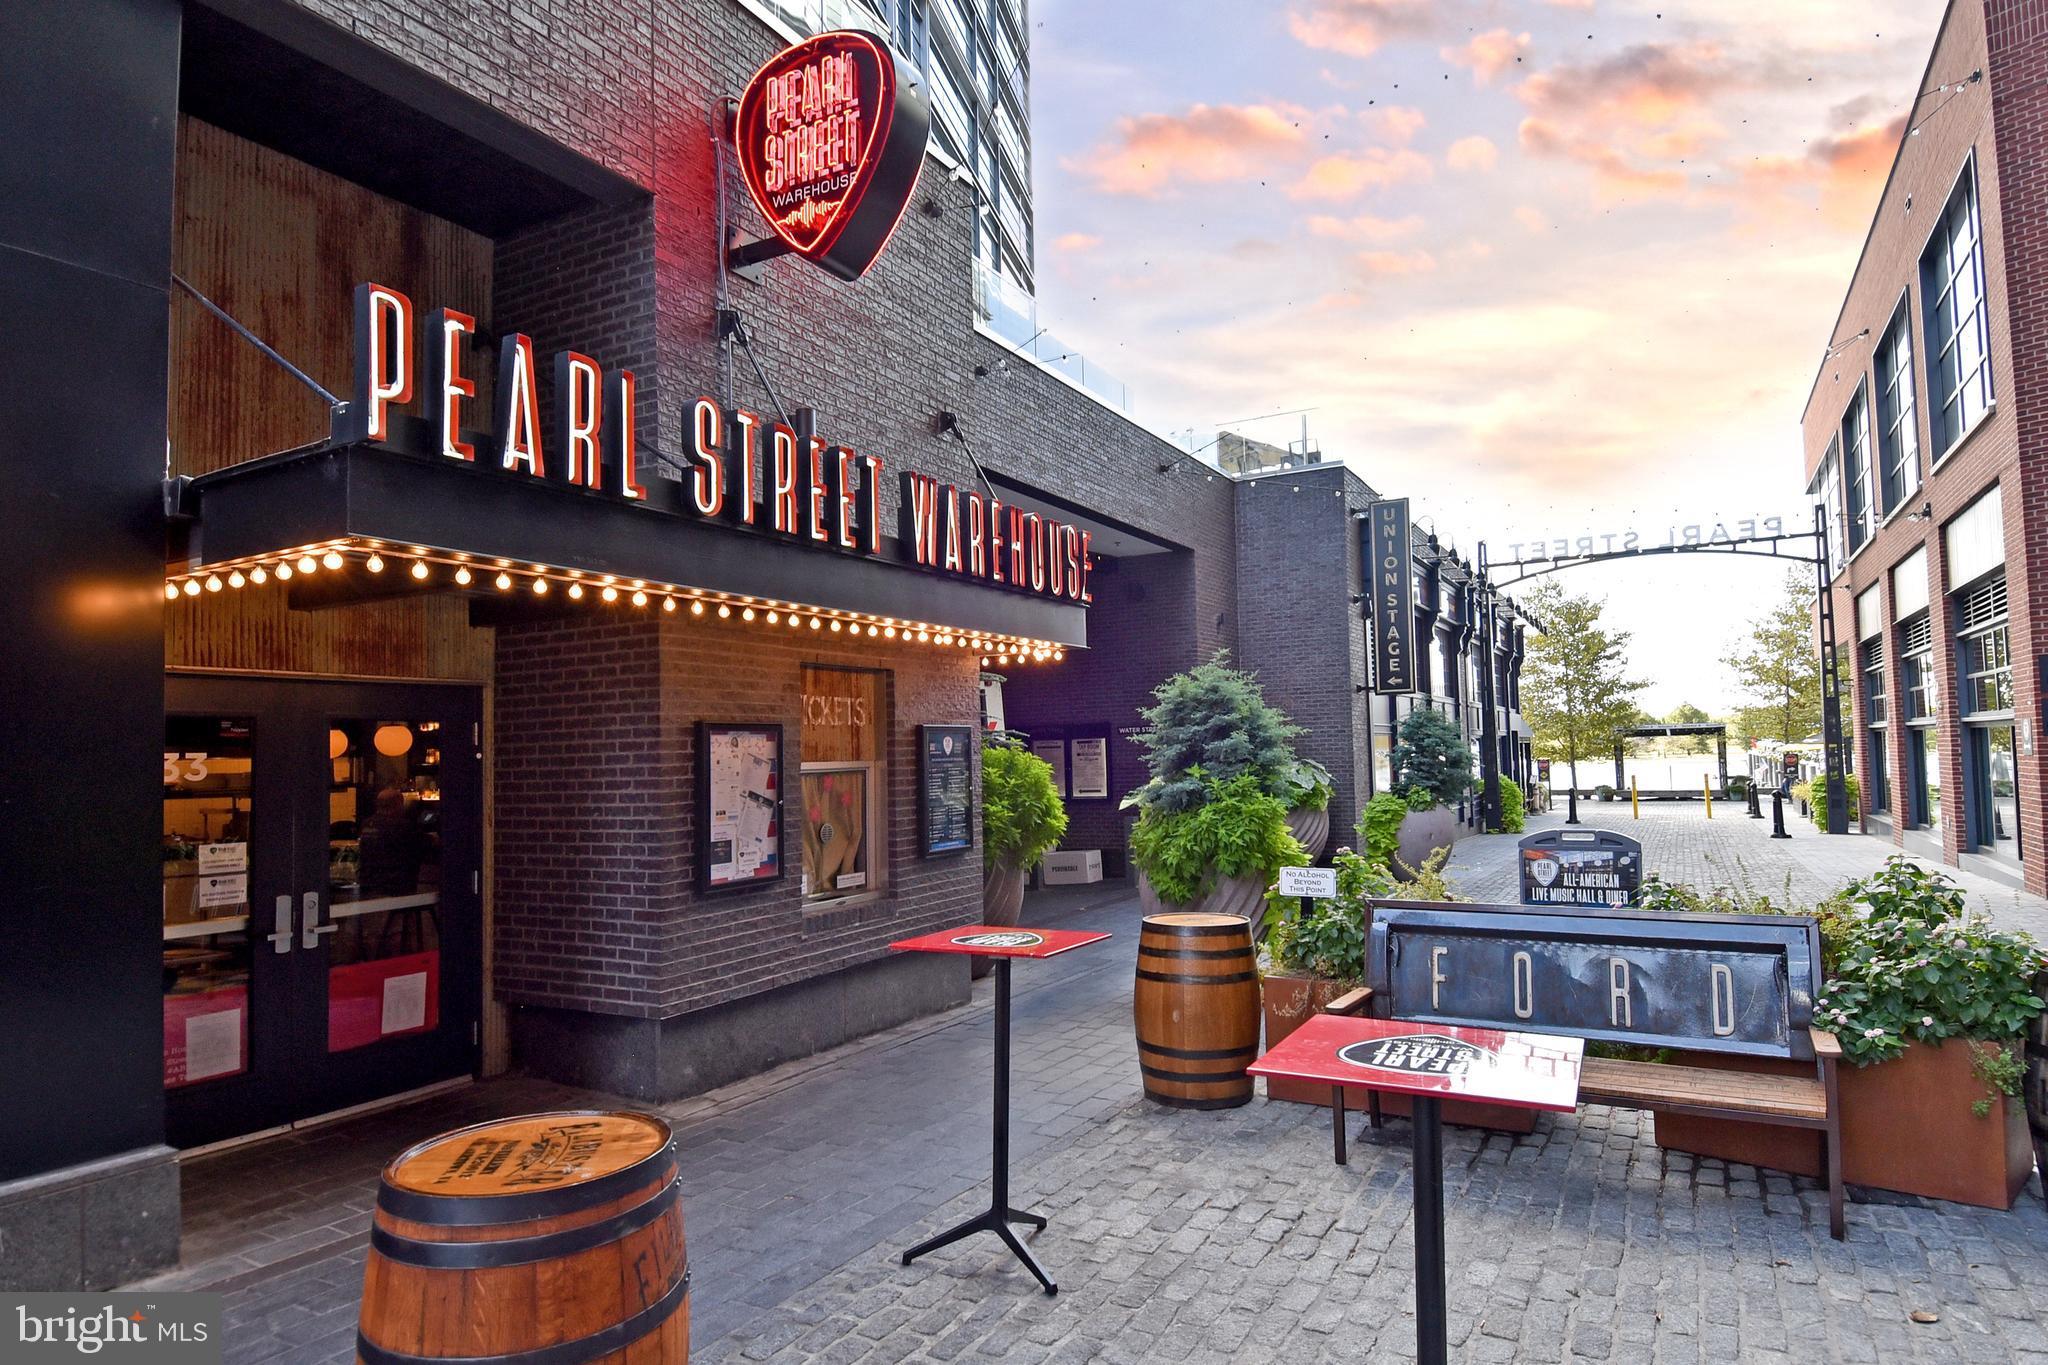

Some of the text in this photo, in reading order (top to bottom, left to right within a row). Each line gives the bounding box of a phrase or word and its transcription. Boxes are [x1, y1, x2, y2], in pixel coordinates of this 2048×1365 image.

[766, 51, 858, 134] PEARL
[765, 109, 860, 192] STREET
[773, 172, 857, 208] WAREHOUSE
[357, 282, 1093, 603] PEARL STREET WAREHOUSE
[1383, 508, 1401, 672] UNION STAGE
[800, 694, 866, 727] ICKETS
[1532, 887, 1629, 905] LIVE MUSIC HALL & DINER
[1562, 873, 1620, 888] ALL-AMERICAN
[1431, 946, 1735, 1036] FORD
[1371, 1052, 1470, 1074] PEARL
[1375, 1043, 1474, 1061] STREET
